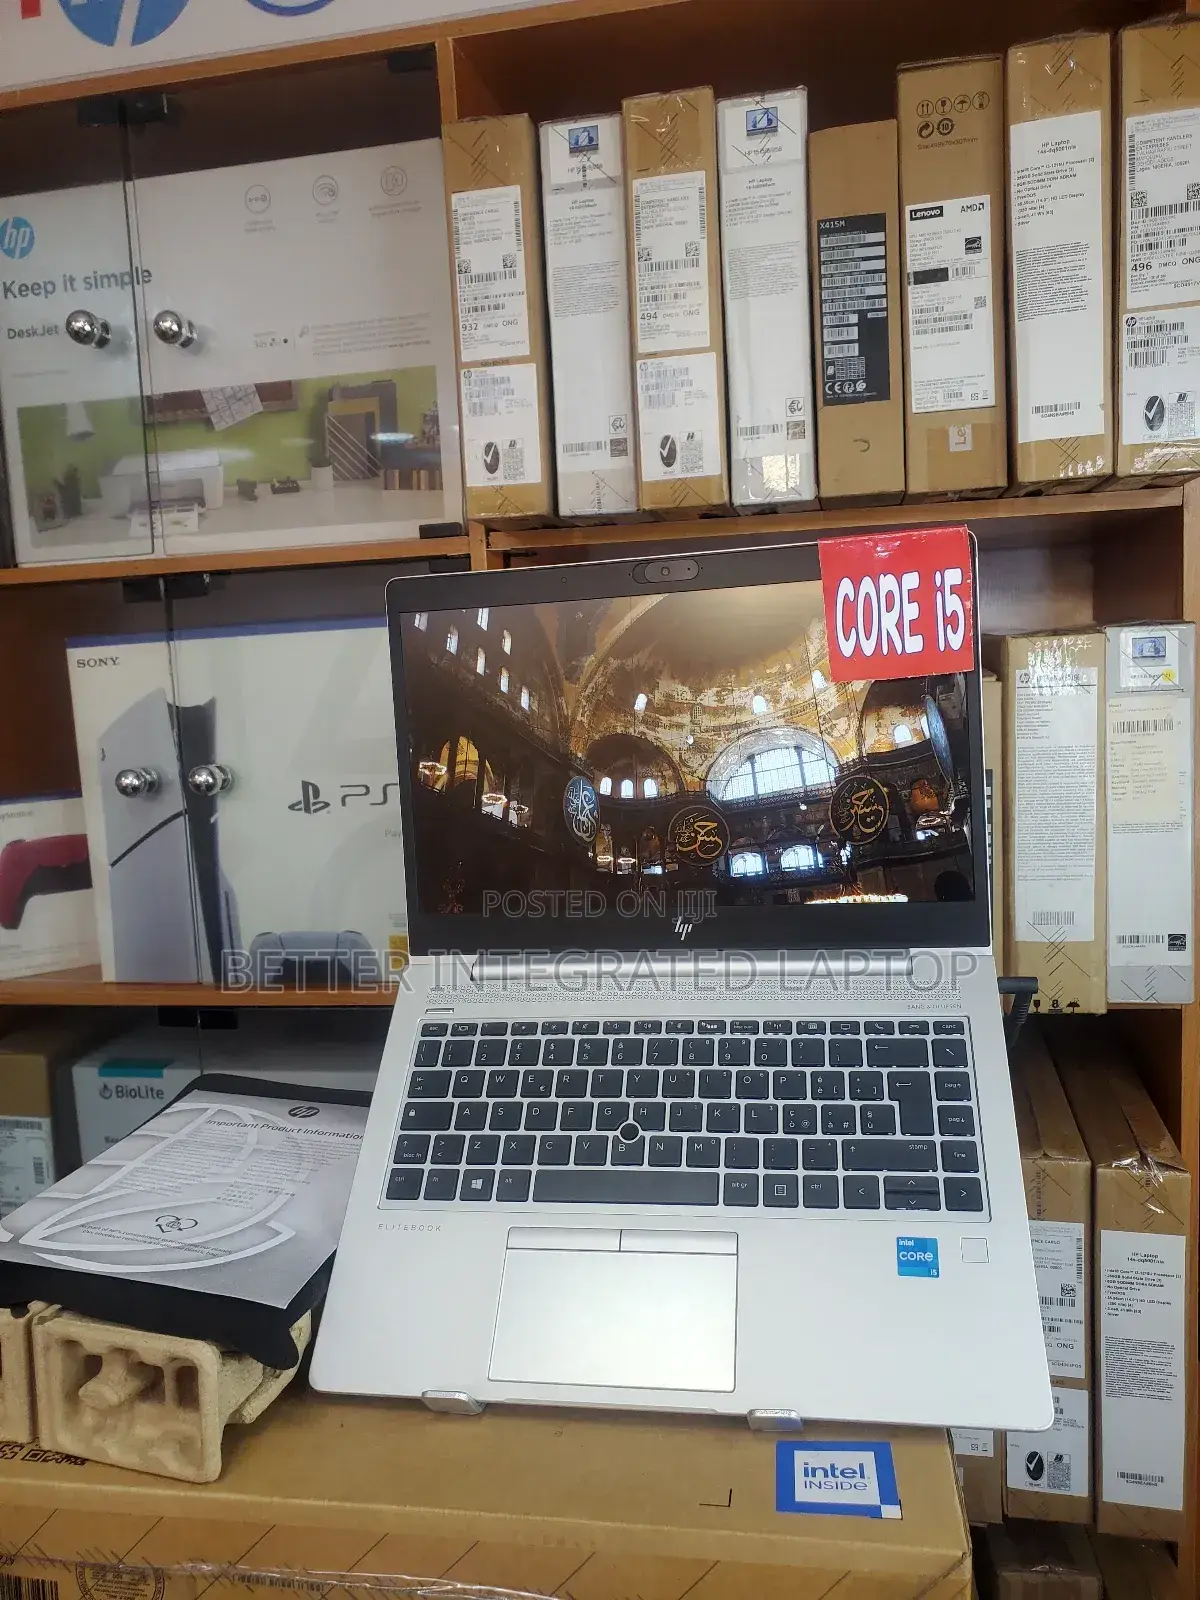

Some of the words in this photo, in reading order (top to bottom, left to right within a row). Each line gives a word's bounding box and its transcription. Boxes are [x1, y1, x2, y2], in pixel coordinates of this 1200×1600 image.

[1166, 133, 1193, 141] HANDLERS
[911, 209, 941, 219] Lenovo
[961, 203, 978, 213] AMD
[820, 220, 846, 229] X415M
[1131, 261, 1152, 272] 496
[1181, 256, 1200, 265] ONG
[2, 280, 56, 299] Keep
[62, 273, 77, 292] it
[83, 266, 152, 291] simple
[640, 312, 657, 320] 494
[683, 309, 699, 317] ONG
[461, 323, 478, 331] 932
[502, 319, 518, 327] ONG
[7, 324, 60, 339] DeskJet
[836, 571, 924, 658] CORE
[934, 567, 966, 652] i5
[77, 656, 120, 669] SONY
[461, 1075, 469, 1083] Q
[495, 1075, 505, 1083] W
[529, 1075, 535, 1083] E
[563, 1075, 570, 1083] R
[598, 1075, 604, 1083] T
[634, 1075, 641, 1083] Y
[669, 1075, 677, 1083] U
[743, 1076, 751, 1084] O
[780, 1076, 787, 1084] P
[115, 1084, 164, 1100] BioLite
[498, 1108, 504, 1116] S
[532, 1108, 540, 1116] D
[567, 1108, 574, 1116] F
[604, 1108, 612, 1116] G
[640, 1108, 647, 1116] H
[714, 1109, 721, 1117] K
[752, 1110, 758, 1118] L
[206, 1119, 259, 1129] Important
[260, 1123, 302, 1134] Product
[801, 1119, 810, 1128] @
[474, 1141, 480, 1149] Z
[510, 1141, 517, 1149] X
[546, 1141, 553, 1149] C
[582, 1141, 590, 1149] V
[619, 1143, 625, 1151] B
[656, 1143, 664, 1151] N
[694, 1143, 703, 1152] M
[378, 1223, 442, 1231] ELITEBOOK
[898, 1239, 914, 1248] intel
[930, 1268, 937, 1276] i5
[1056, 1342, 1074, 1350] ONG
